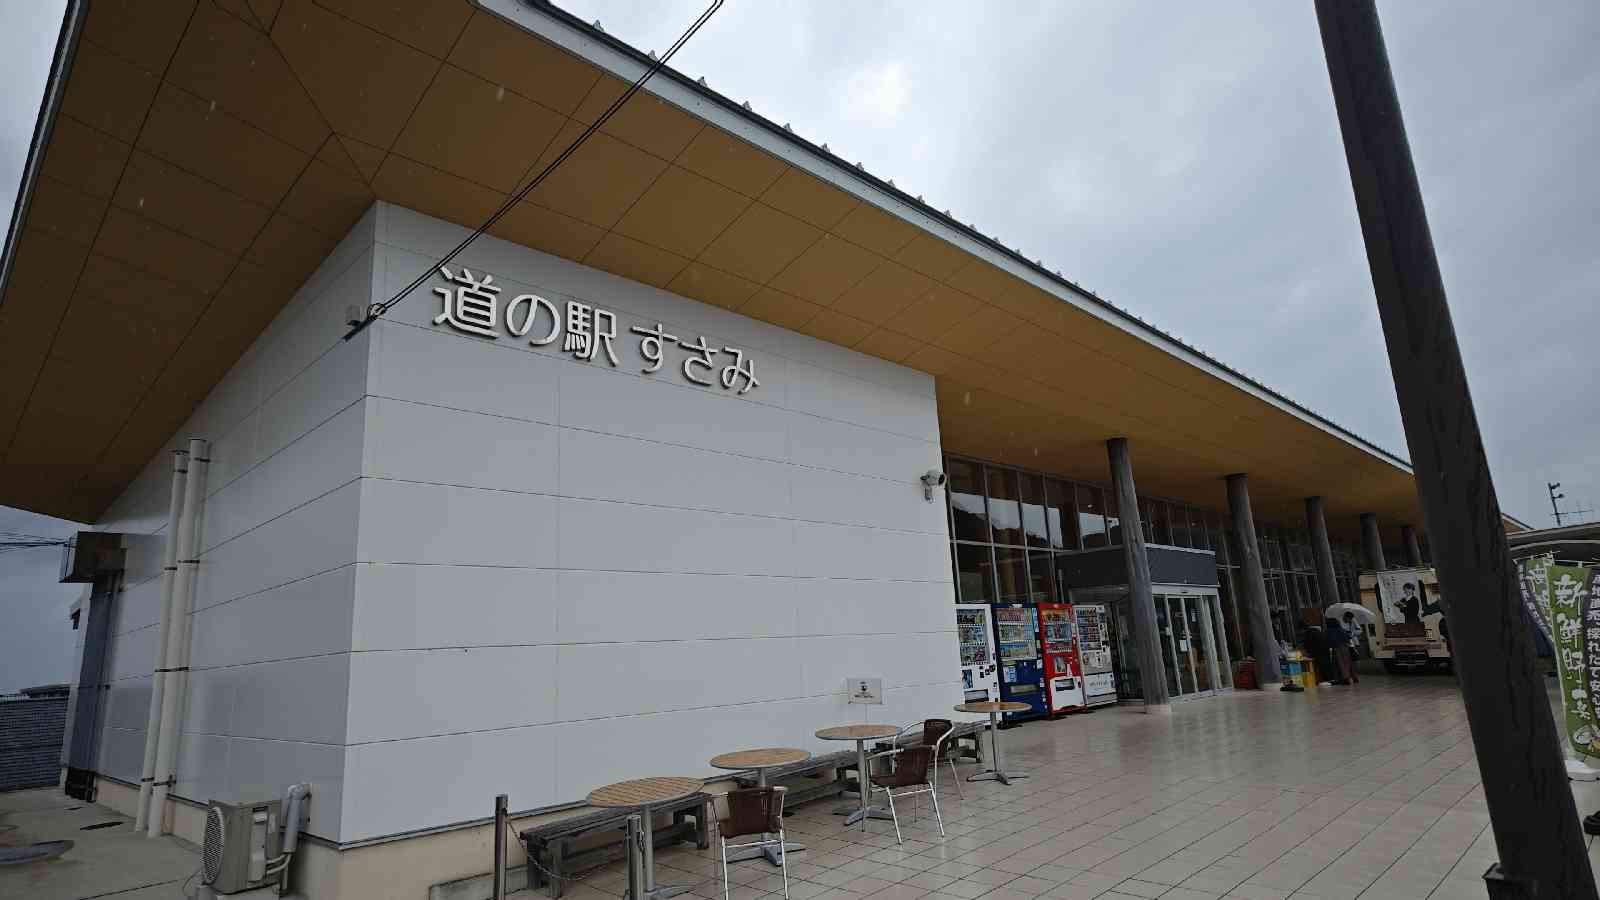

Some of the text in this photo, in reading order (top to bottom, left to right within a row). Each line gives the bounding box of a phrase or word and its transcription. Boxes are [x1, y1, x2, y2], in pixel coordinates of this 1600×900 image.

[432, 266, 760, 395] 道の駅 すさみ
